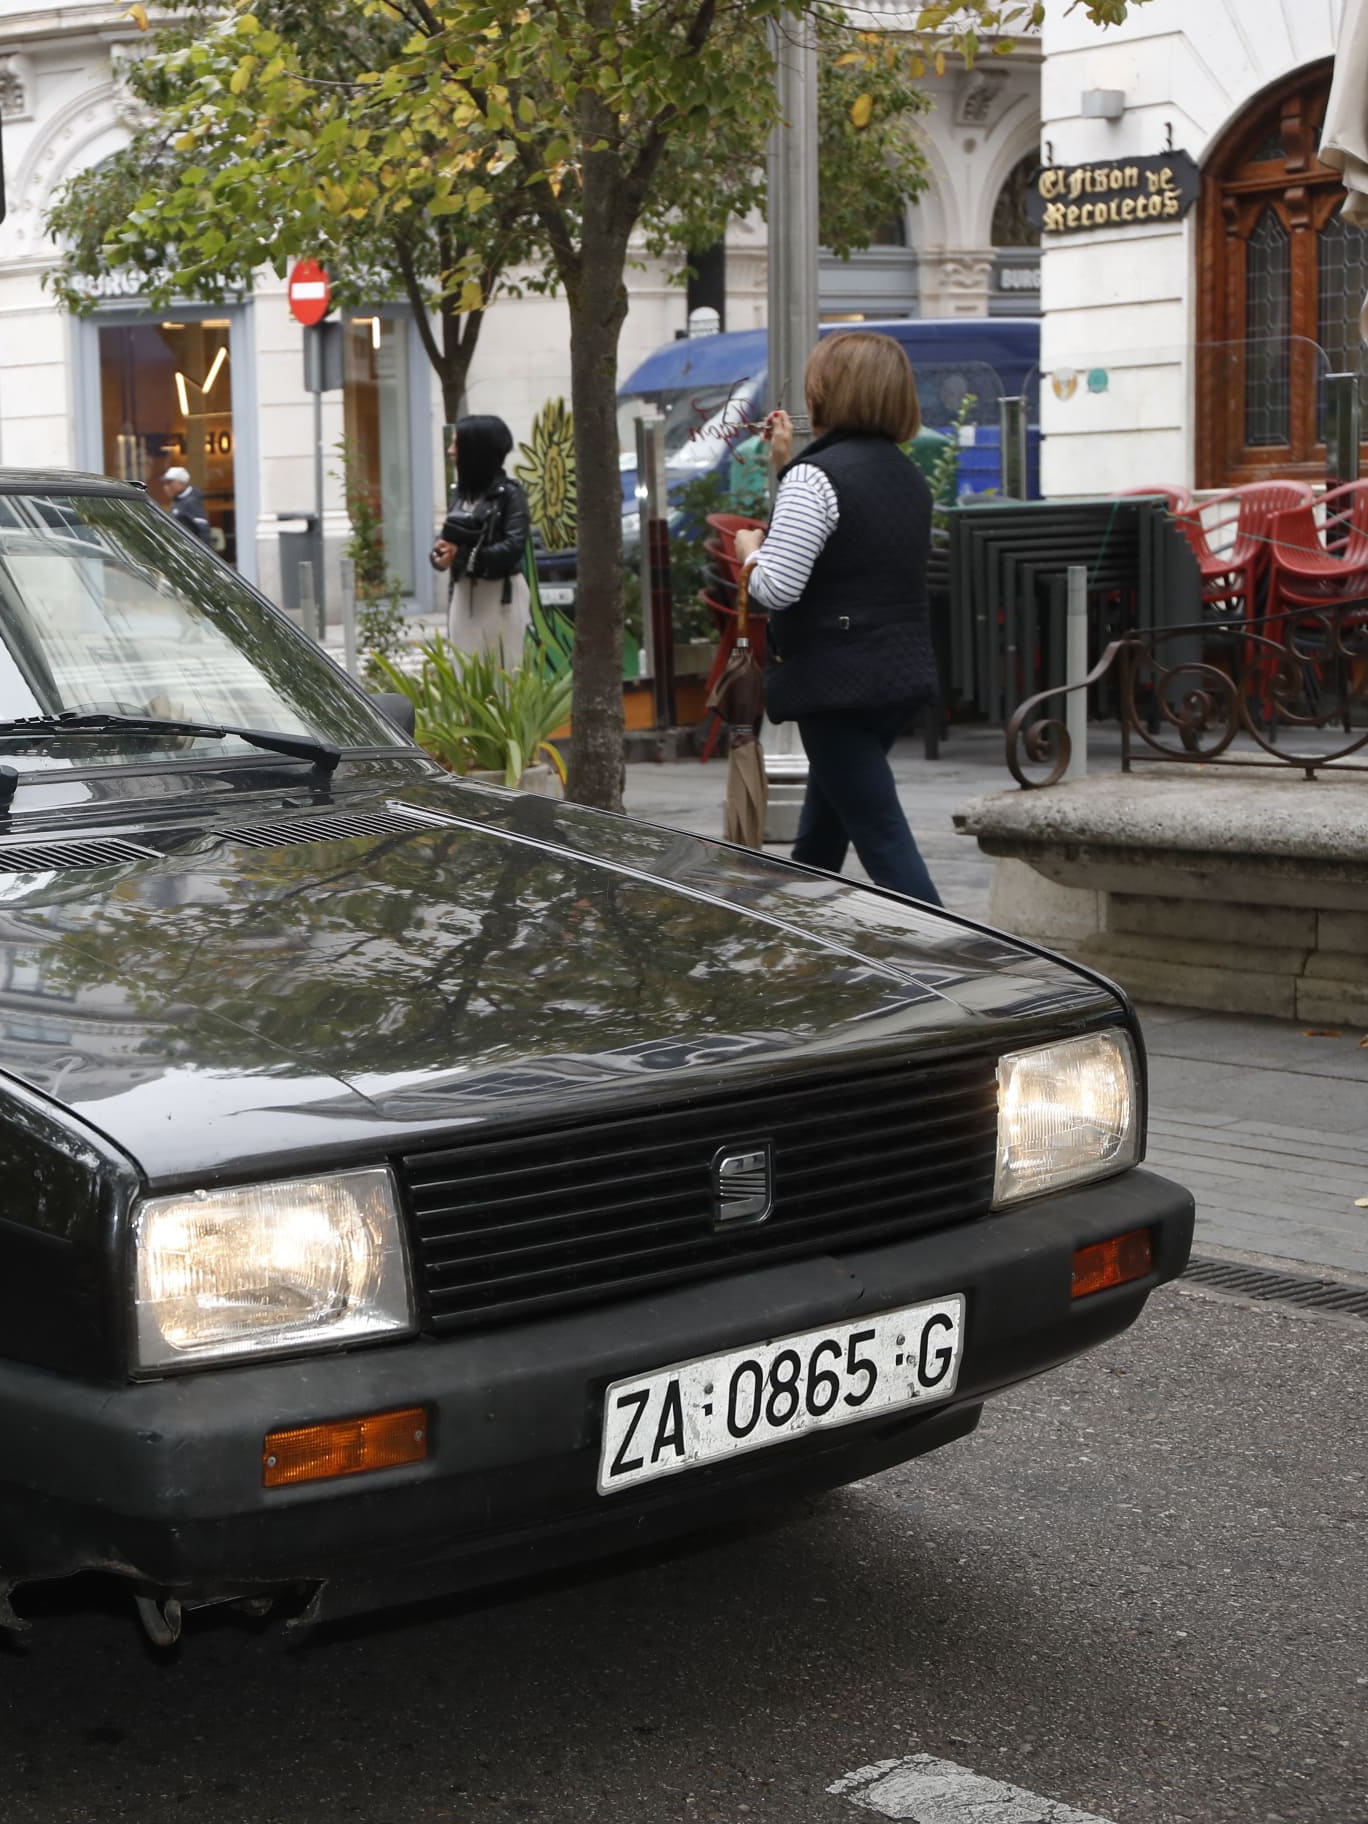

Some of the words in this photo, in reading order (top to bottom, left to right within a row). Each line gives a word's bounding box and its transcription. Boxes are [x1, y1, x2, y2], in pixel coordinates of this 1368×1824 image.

[1038, 168, 1067, 199] El
[1042, 189, 1183, 232] Recoletos
[610, 1378, 686, 1477] ZA
[727, 1328, 878, 1439] 0865
[917, 1312, 954, 1388] G
